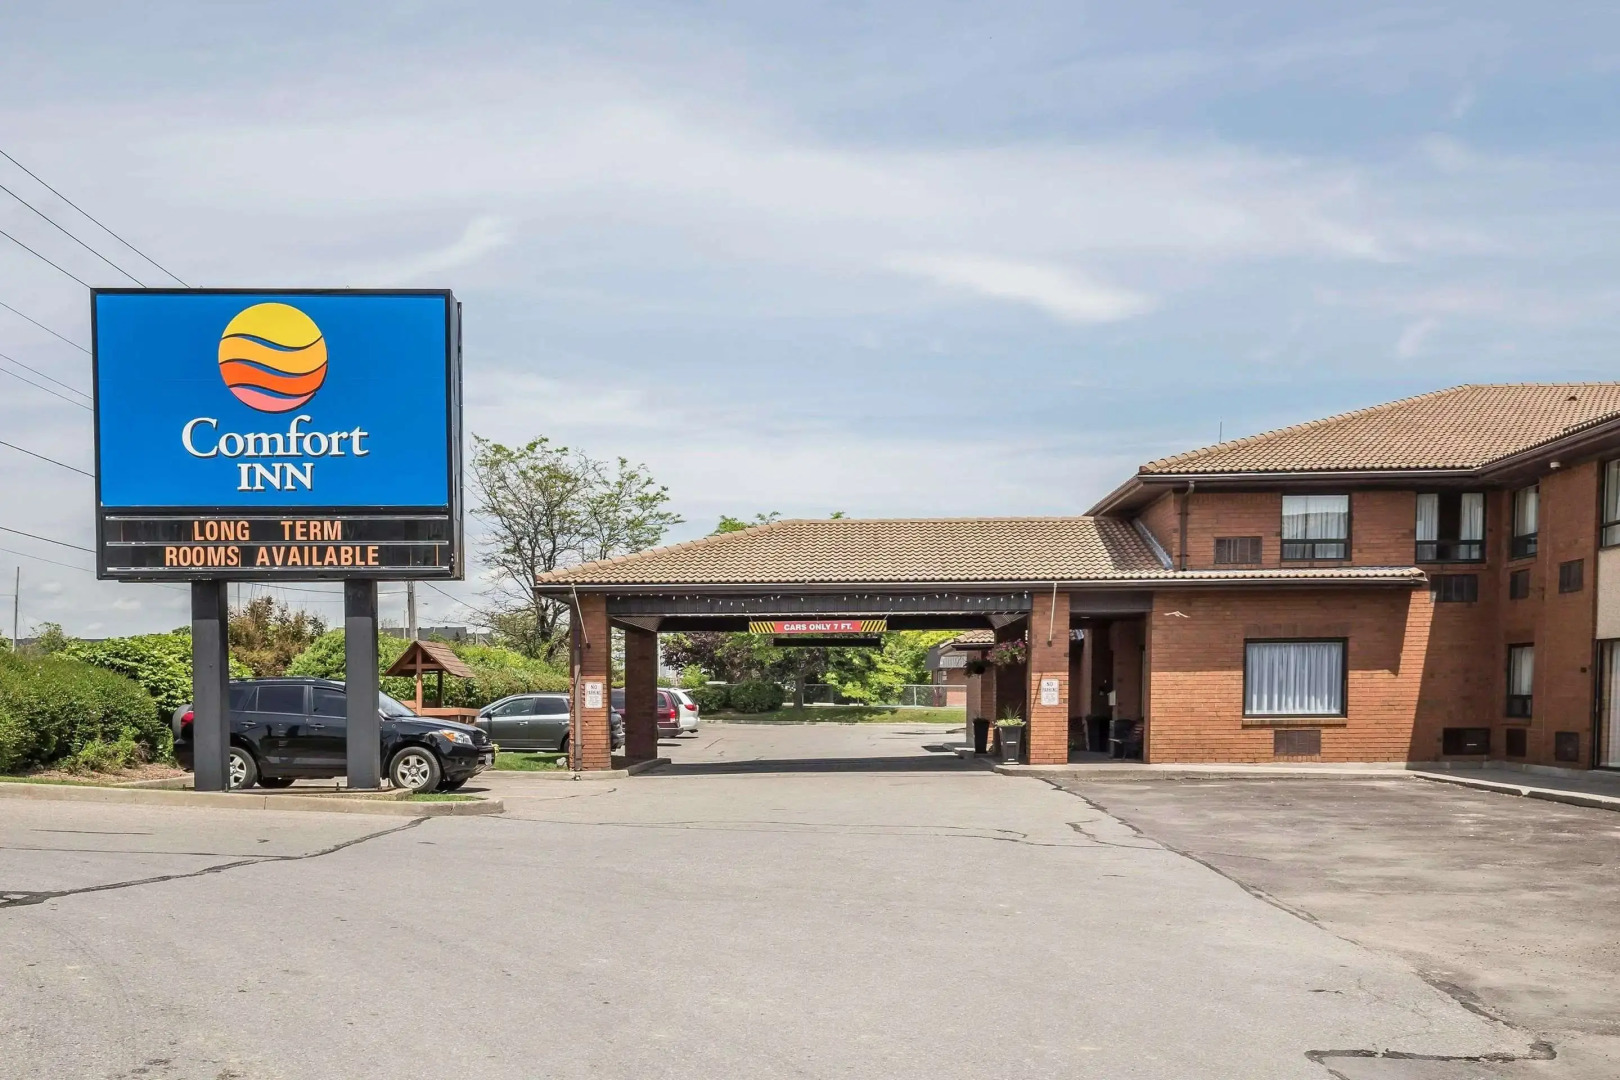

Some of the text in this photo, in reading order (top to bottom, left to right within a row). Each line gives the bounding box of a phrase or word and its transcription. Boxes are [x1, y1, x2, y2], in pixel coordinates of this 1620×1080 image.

[182, 414, 369, 458] Comfort
[236, 462, 315, 491] INN
[193, 520, 342, 541] LONG TERM
[165, 545, 380, 567] ROOMS AVAILABLE
[783, 623, 807, 631] CARS
[809, 623, 831, 631] ONLY
